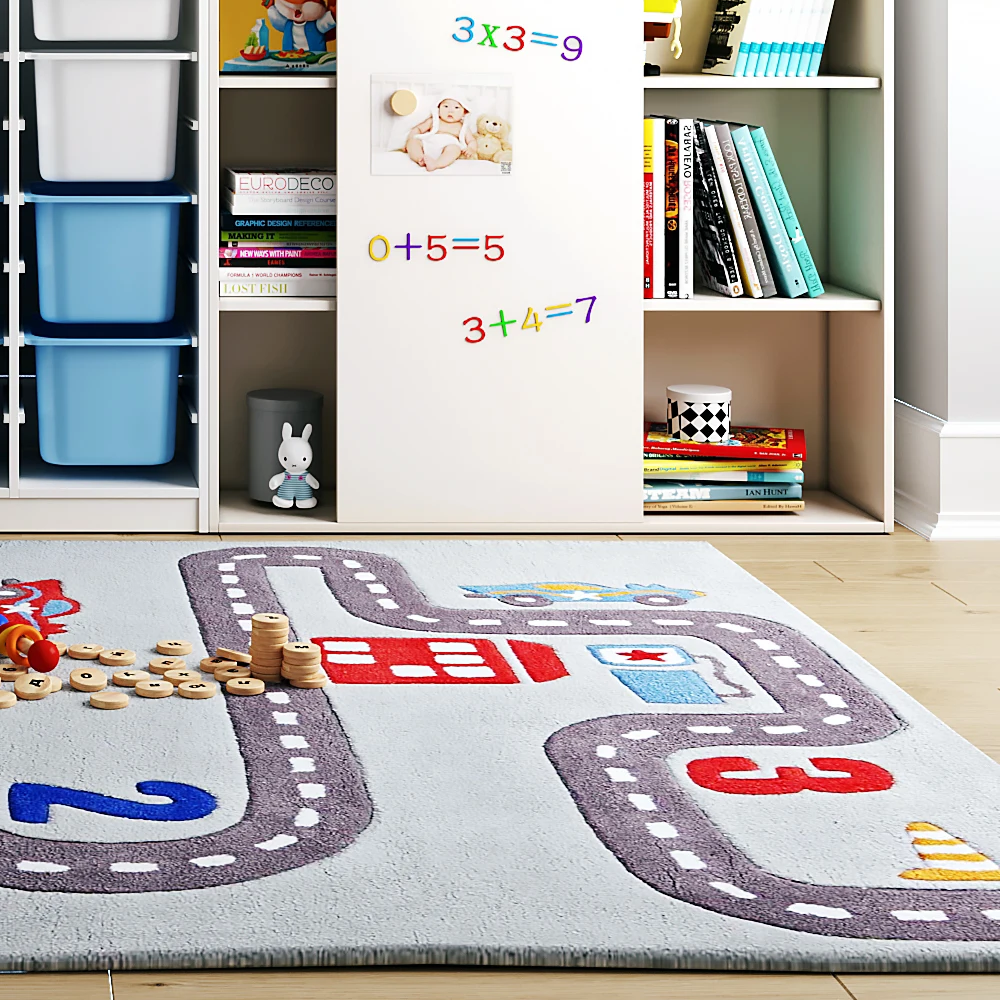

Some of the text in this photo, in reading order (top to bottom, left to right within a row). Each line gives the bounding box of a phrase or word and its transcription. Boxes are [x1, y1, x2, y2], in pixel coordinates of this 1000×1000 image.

[240, 177, 334, 191] EURODECO
[240, 249, 252, 258] NEW
[252, 249, 269, 258] WAYS
[270, 249, 285, 258] WITH
[285, 249, 302, 258] PAINT
[223, 283, 287, 294] LOST FISH
[643, 488, 711, 500] STEAM
[763, 488, 789, 496] HUNT
[29, 678, 45, 688] A
[8, 780, 217, 824] 2
